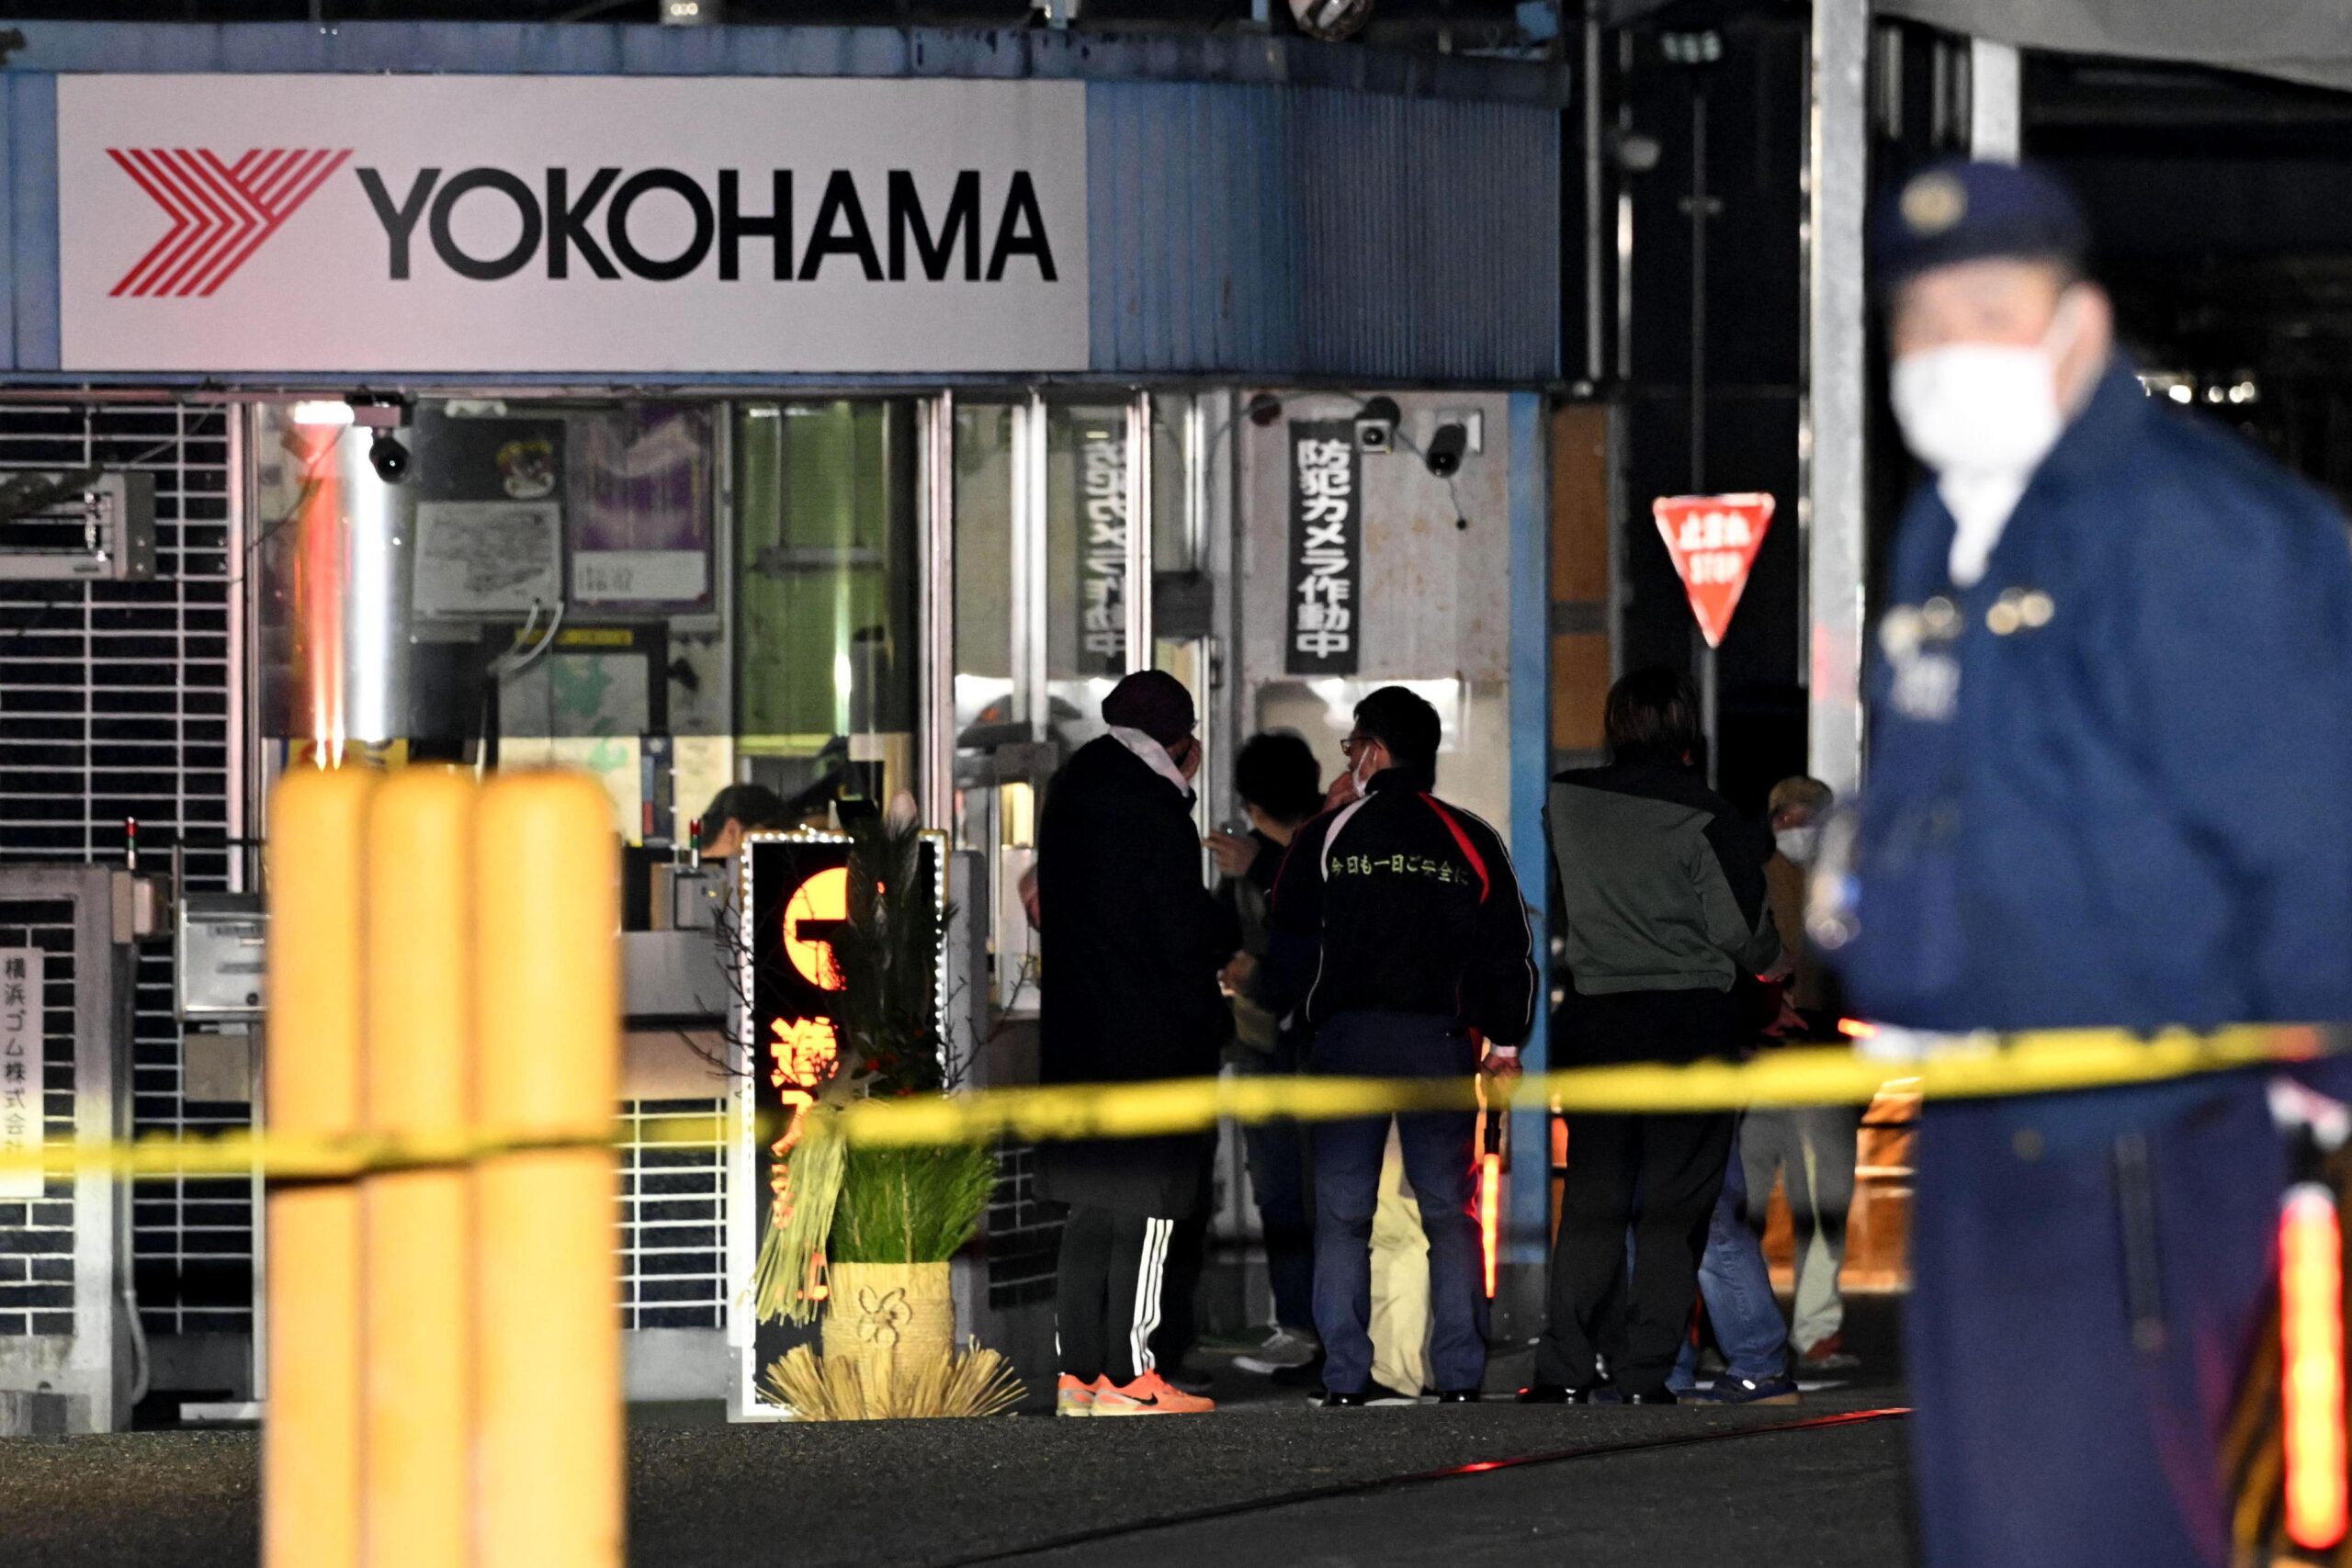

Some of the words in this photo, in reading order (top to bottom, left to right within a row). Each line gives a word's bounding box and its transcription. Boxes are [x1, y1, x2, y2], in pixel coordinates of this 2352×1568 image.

[356, 167, 1058, 282] YOKOHAMA
[1295, 438, 1353, 660] 防犯カメラ作動中
